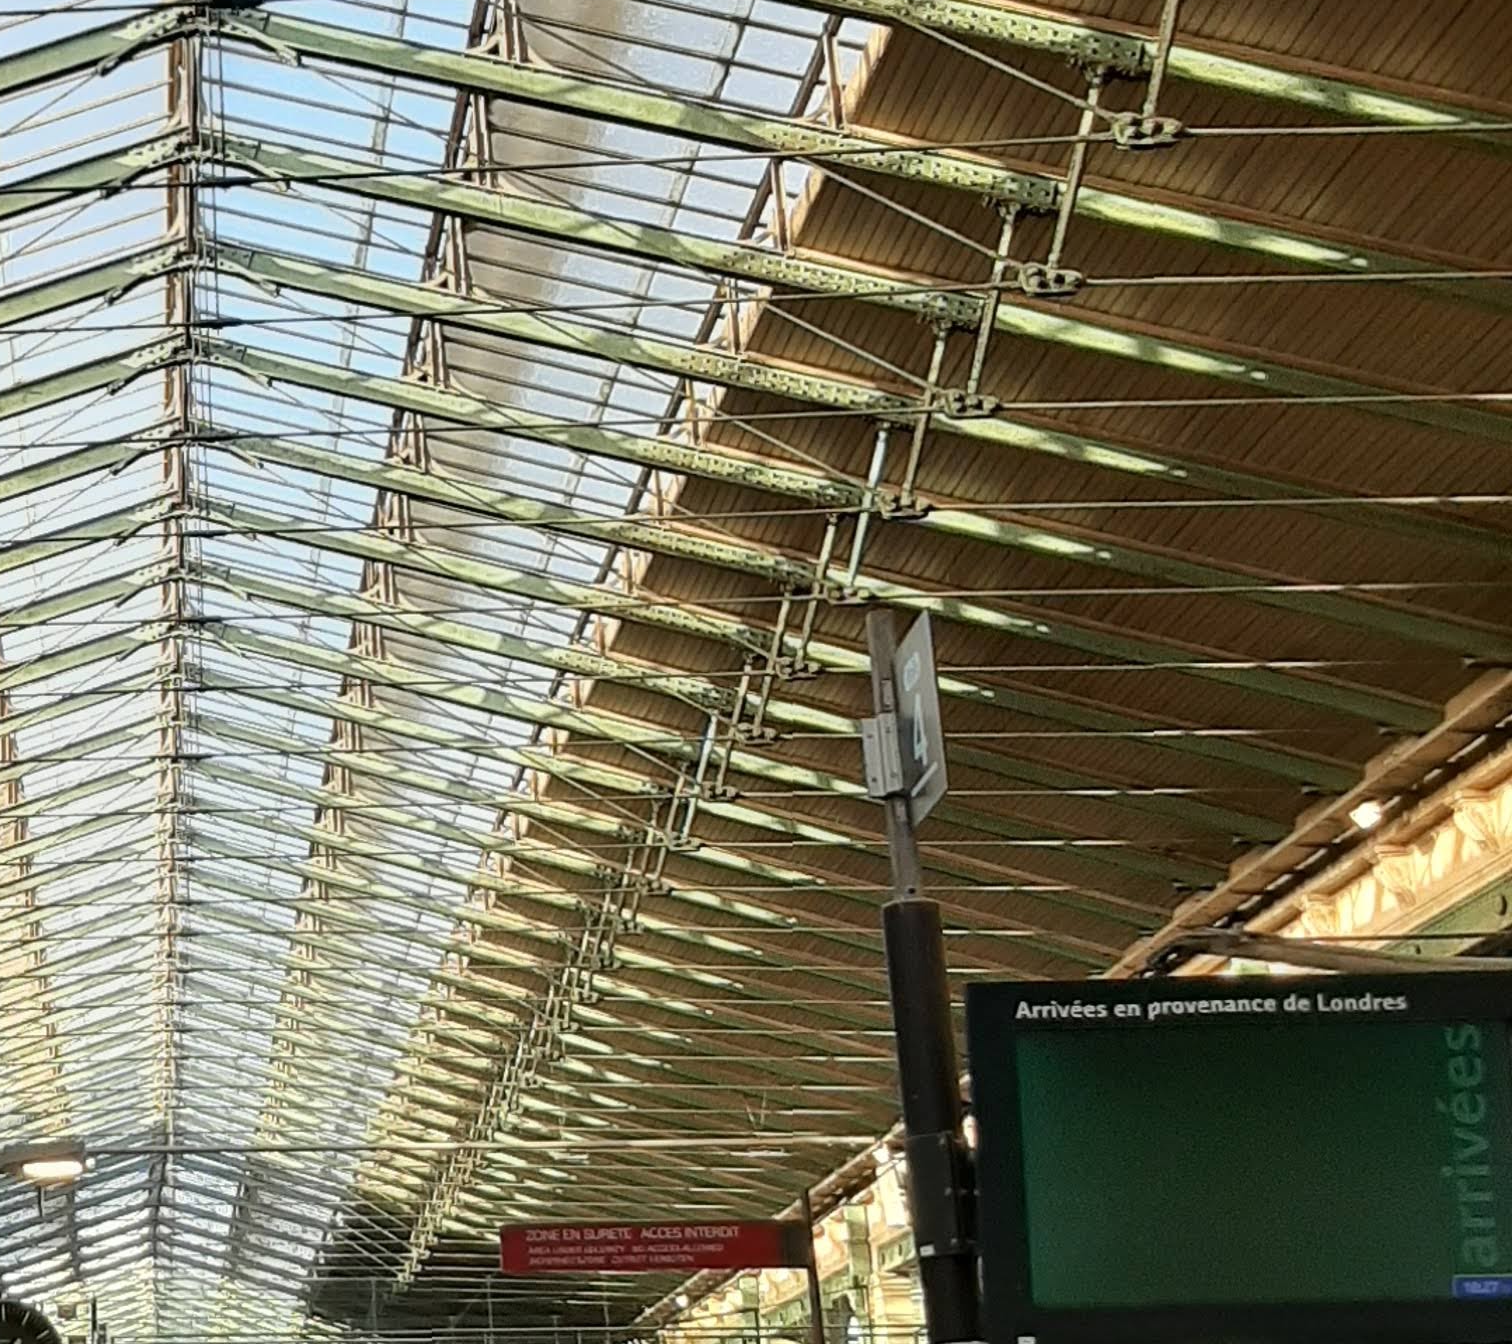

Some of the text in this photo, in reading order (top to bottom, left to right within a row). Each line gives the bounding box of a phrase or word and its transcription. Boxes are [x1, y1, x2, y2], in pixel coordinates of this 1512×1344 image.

[1015, 991, 1408, 1021] Arrivées en provenance de Londres
[1437, 1023, 1497, 1268] arrivées
[526, 1228, 560, 1241] ZONE
[563, 1228, 580, 1240] EN
[685, 1225, 738, 1239] INTERDIT
